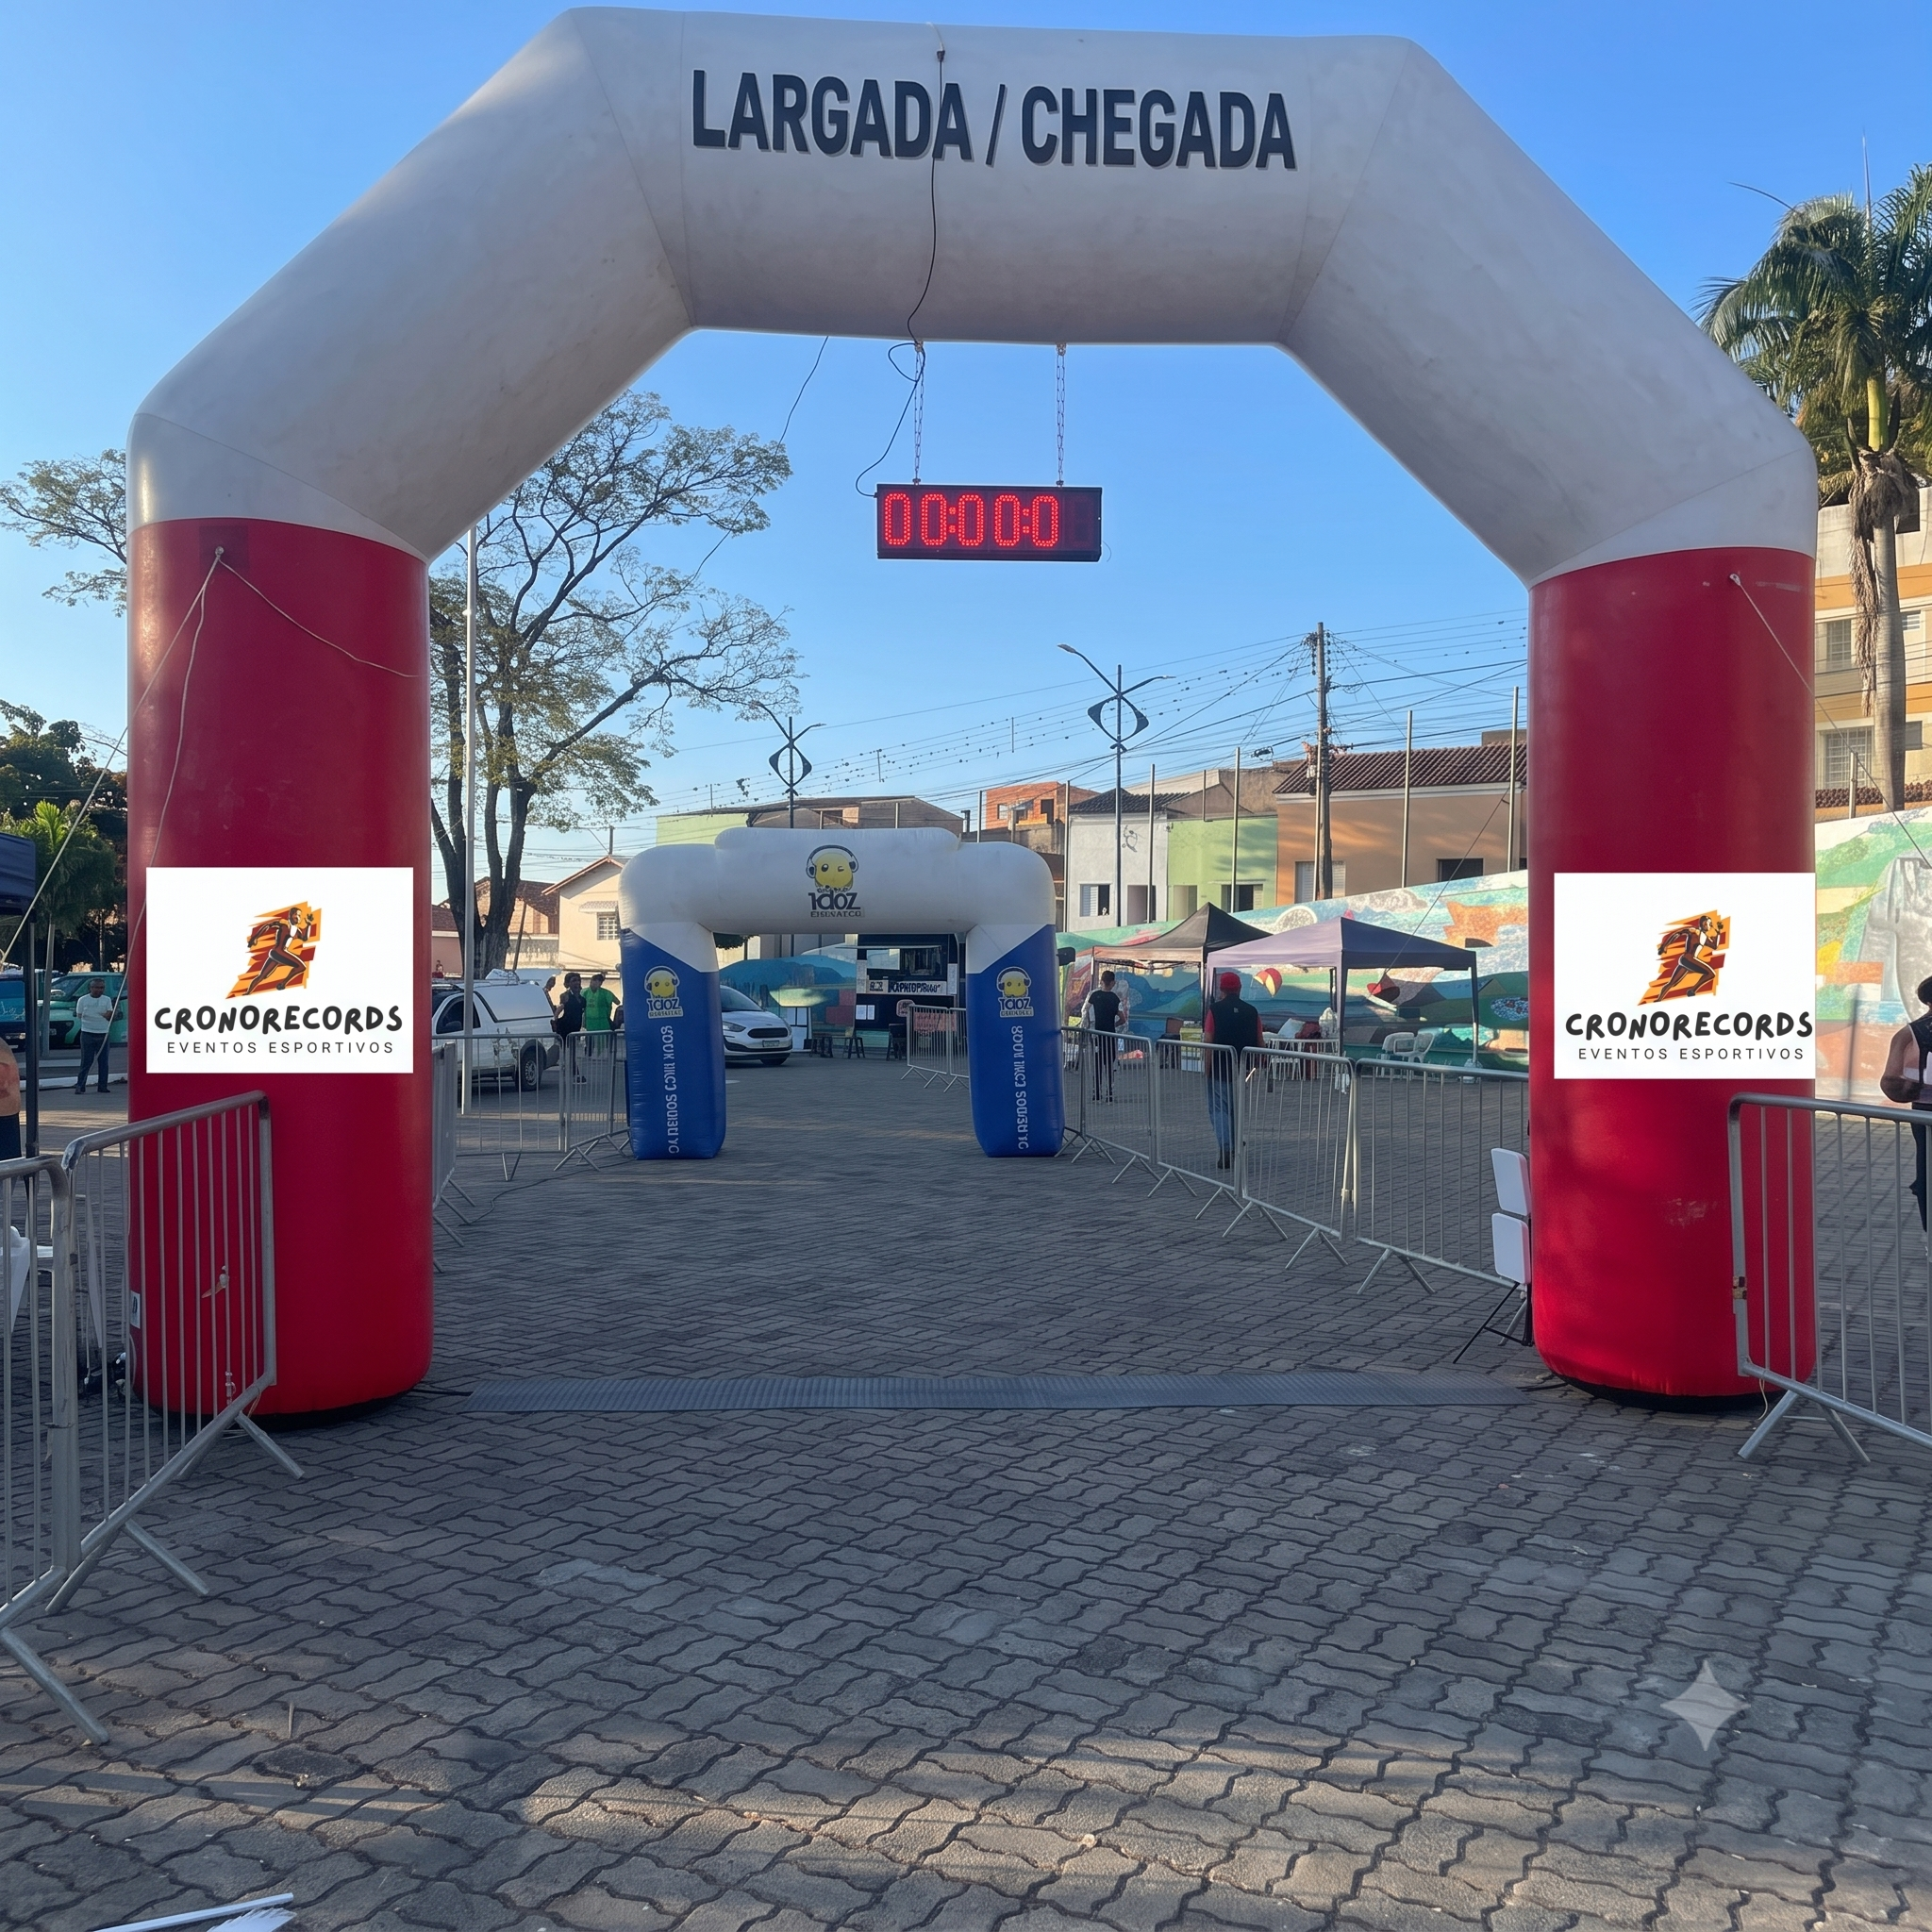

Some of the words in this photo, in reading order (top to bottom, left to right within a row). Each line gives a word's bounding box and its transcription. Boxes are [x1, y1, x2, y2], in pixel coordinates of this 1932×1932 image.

[692, 69, 974, 161] LARGADA
[1021, 85, 1297, 170] CHEGADA
[154, 1005, 403, 1035] CRONORECORDS
[1565, 1010, 1813, 1041] CRONORECORDS
[167, 1041, 258, 1054] EVENTOS
[269, 1041, 393, 1054] ESPORTIVOS
[1578, 1048, 1668, 1060] EVENTOS
[1679, 1048, 1804, 1060] ESPORTIVOS
